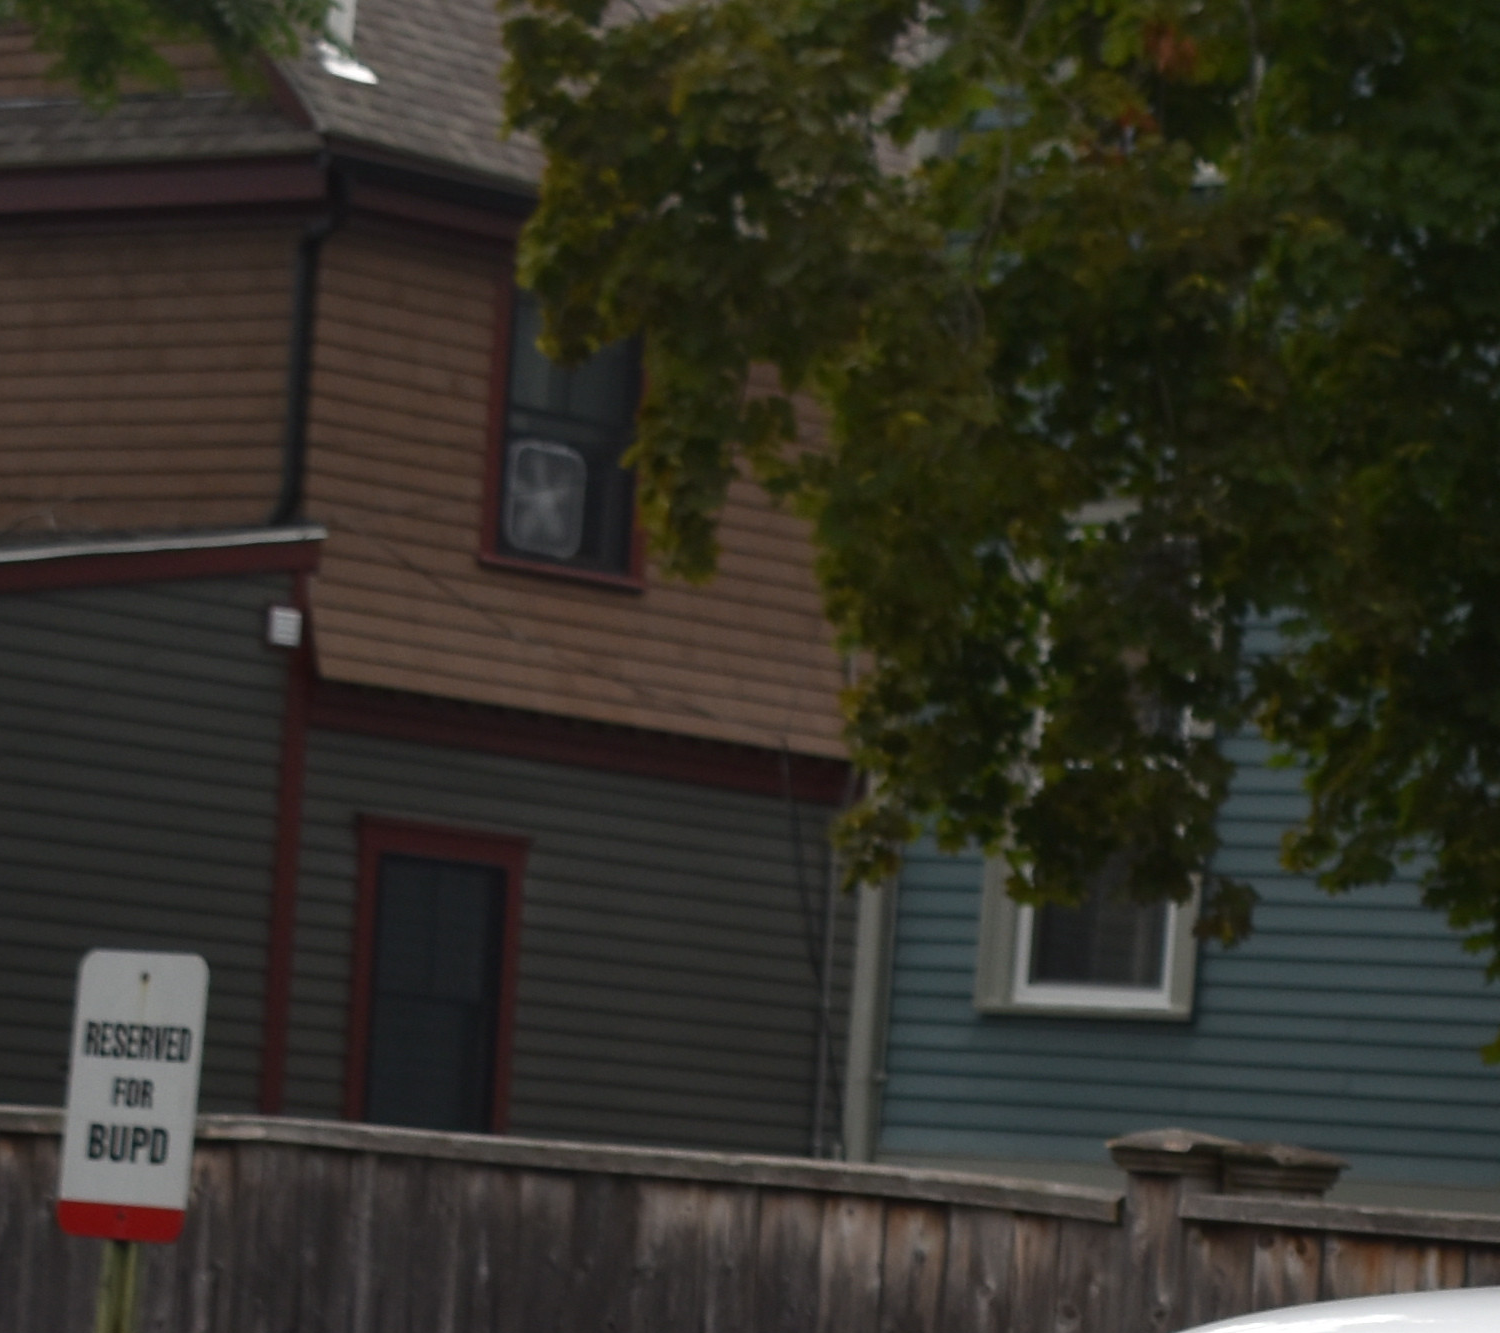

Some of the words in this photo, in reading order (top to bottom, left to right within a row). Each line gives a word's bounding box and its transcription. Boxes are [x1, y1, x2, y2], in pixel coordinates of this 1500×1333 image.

[84, 1020, 192, 1063] RESERVED
[112, 1076, 154, 1109] FOR
[86, 1123, 169, 1164] BUPD
